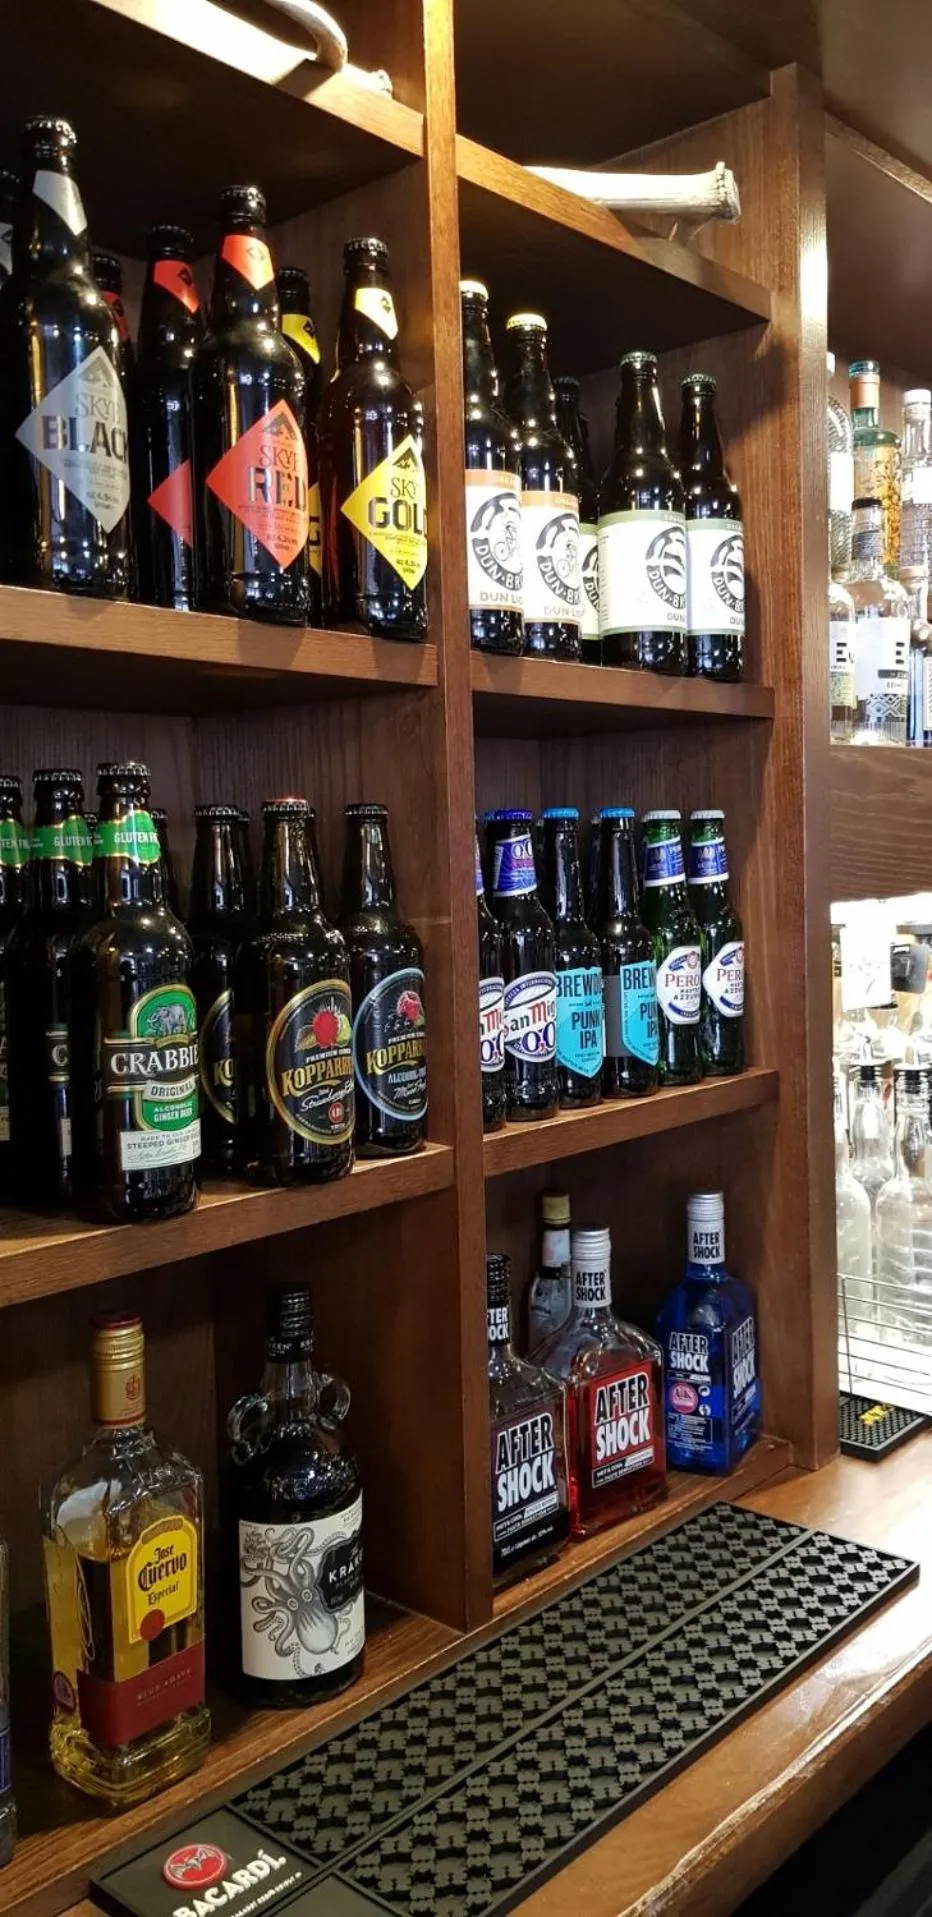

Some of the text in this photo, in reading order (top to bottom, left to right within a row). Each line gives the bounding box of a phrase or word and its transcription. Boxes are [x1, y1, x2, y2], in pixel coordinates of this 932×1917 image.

[664, 973, 699, 988] PERO
[580, 1030, 598, 1051] IPA
[151, 1080, 193, 1098] ORIGINAL
[693, 1231, 720, 1246] AFTER
[693, 1244, 721, 1260] SHOCK
[575, 1271, 605, 1287] AFTER
[575, 1286, 605, 1302] SHOCK
[487, 1307, 508, 1324] TER
[488, 1323, 509, 1341] OCK
[669, 1331, 708, 1352] AFTER
[732, 1316, 755, 1368] AFTER
[669, 1351, 709, 1373] SHOCK
[733, 1350, 756, 1400] SHOCK
[594, 1372, 649, 1427] AFTER
[495, 1412, 554, 1474] AFTER
[596, 1408, 651, 1462] SHOCK
[497, 1450, 555, 1513] SHOCK
[154, 1544, 174, 1565] Jose
[137, 1552, 188, 1593] Cuervo
[148, 1580, 180, 1606] Especial
